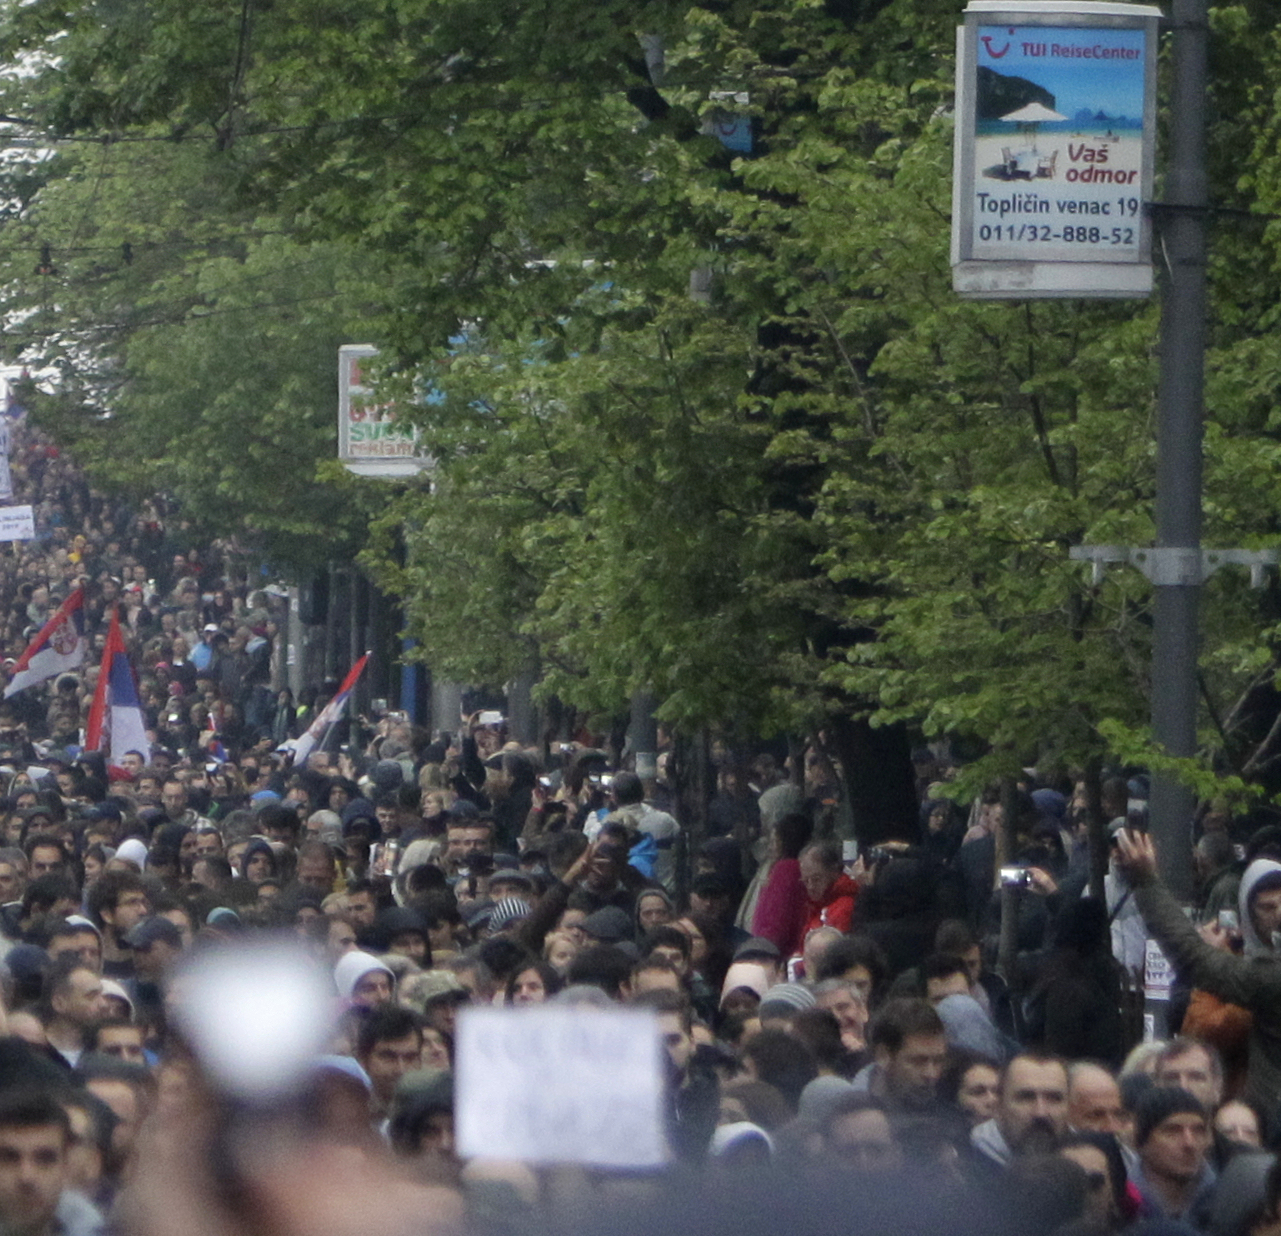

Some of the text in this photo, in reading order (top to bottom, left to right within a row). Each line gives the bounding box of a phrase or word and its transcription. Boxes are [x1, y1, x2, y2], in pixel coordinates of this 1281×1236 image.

[1022, 42, 1140, 60] TUI ReiseCenter
[1068, 143, 1109, 163] Vaš
[1065, 165, 1137, 184] odmor
[977, 193, 1138, 218] Topličin venac 19
[979, 225, 1133, 244] 011/32-888-52
